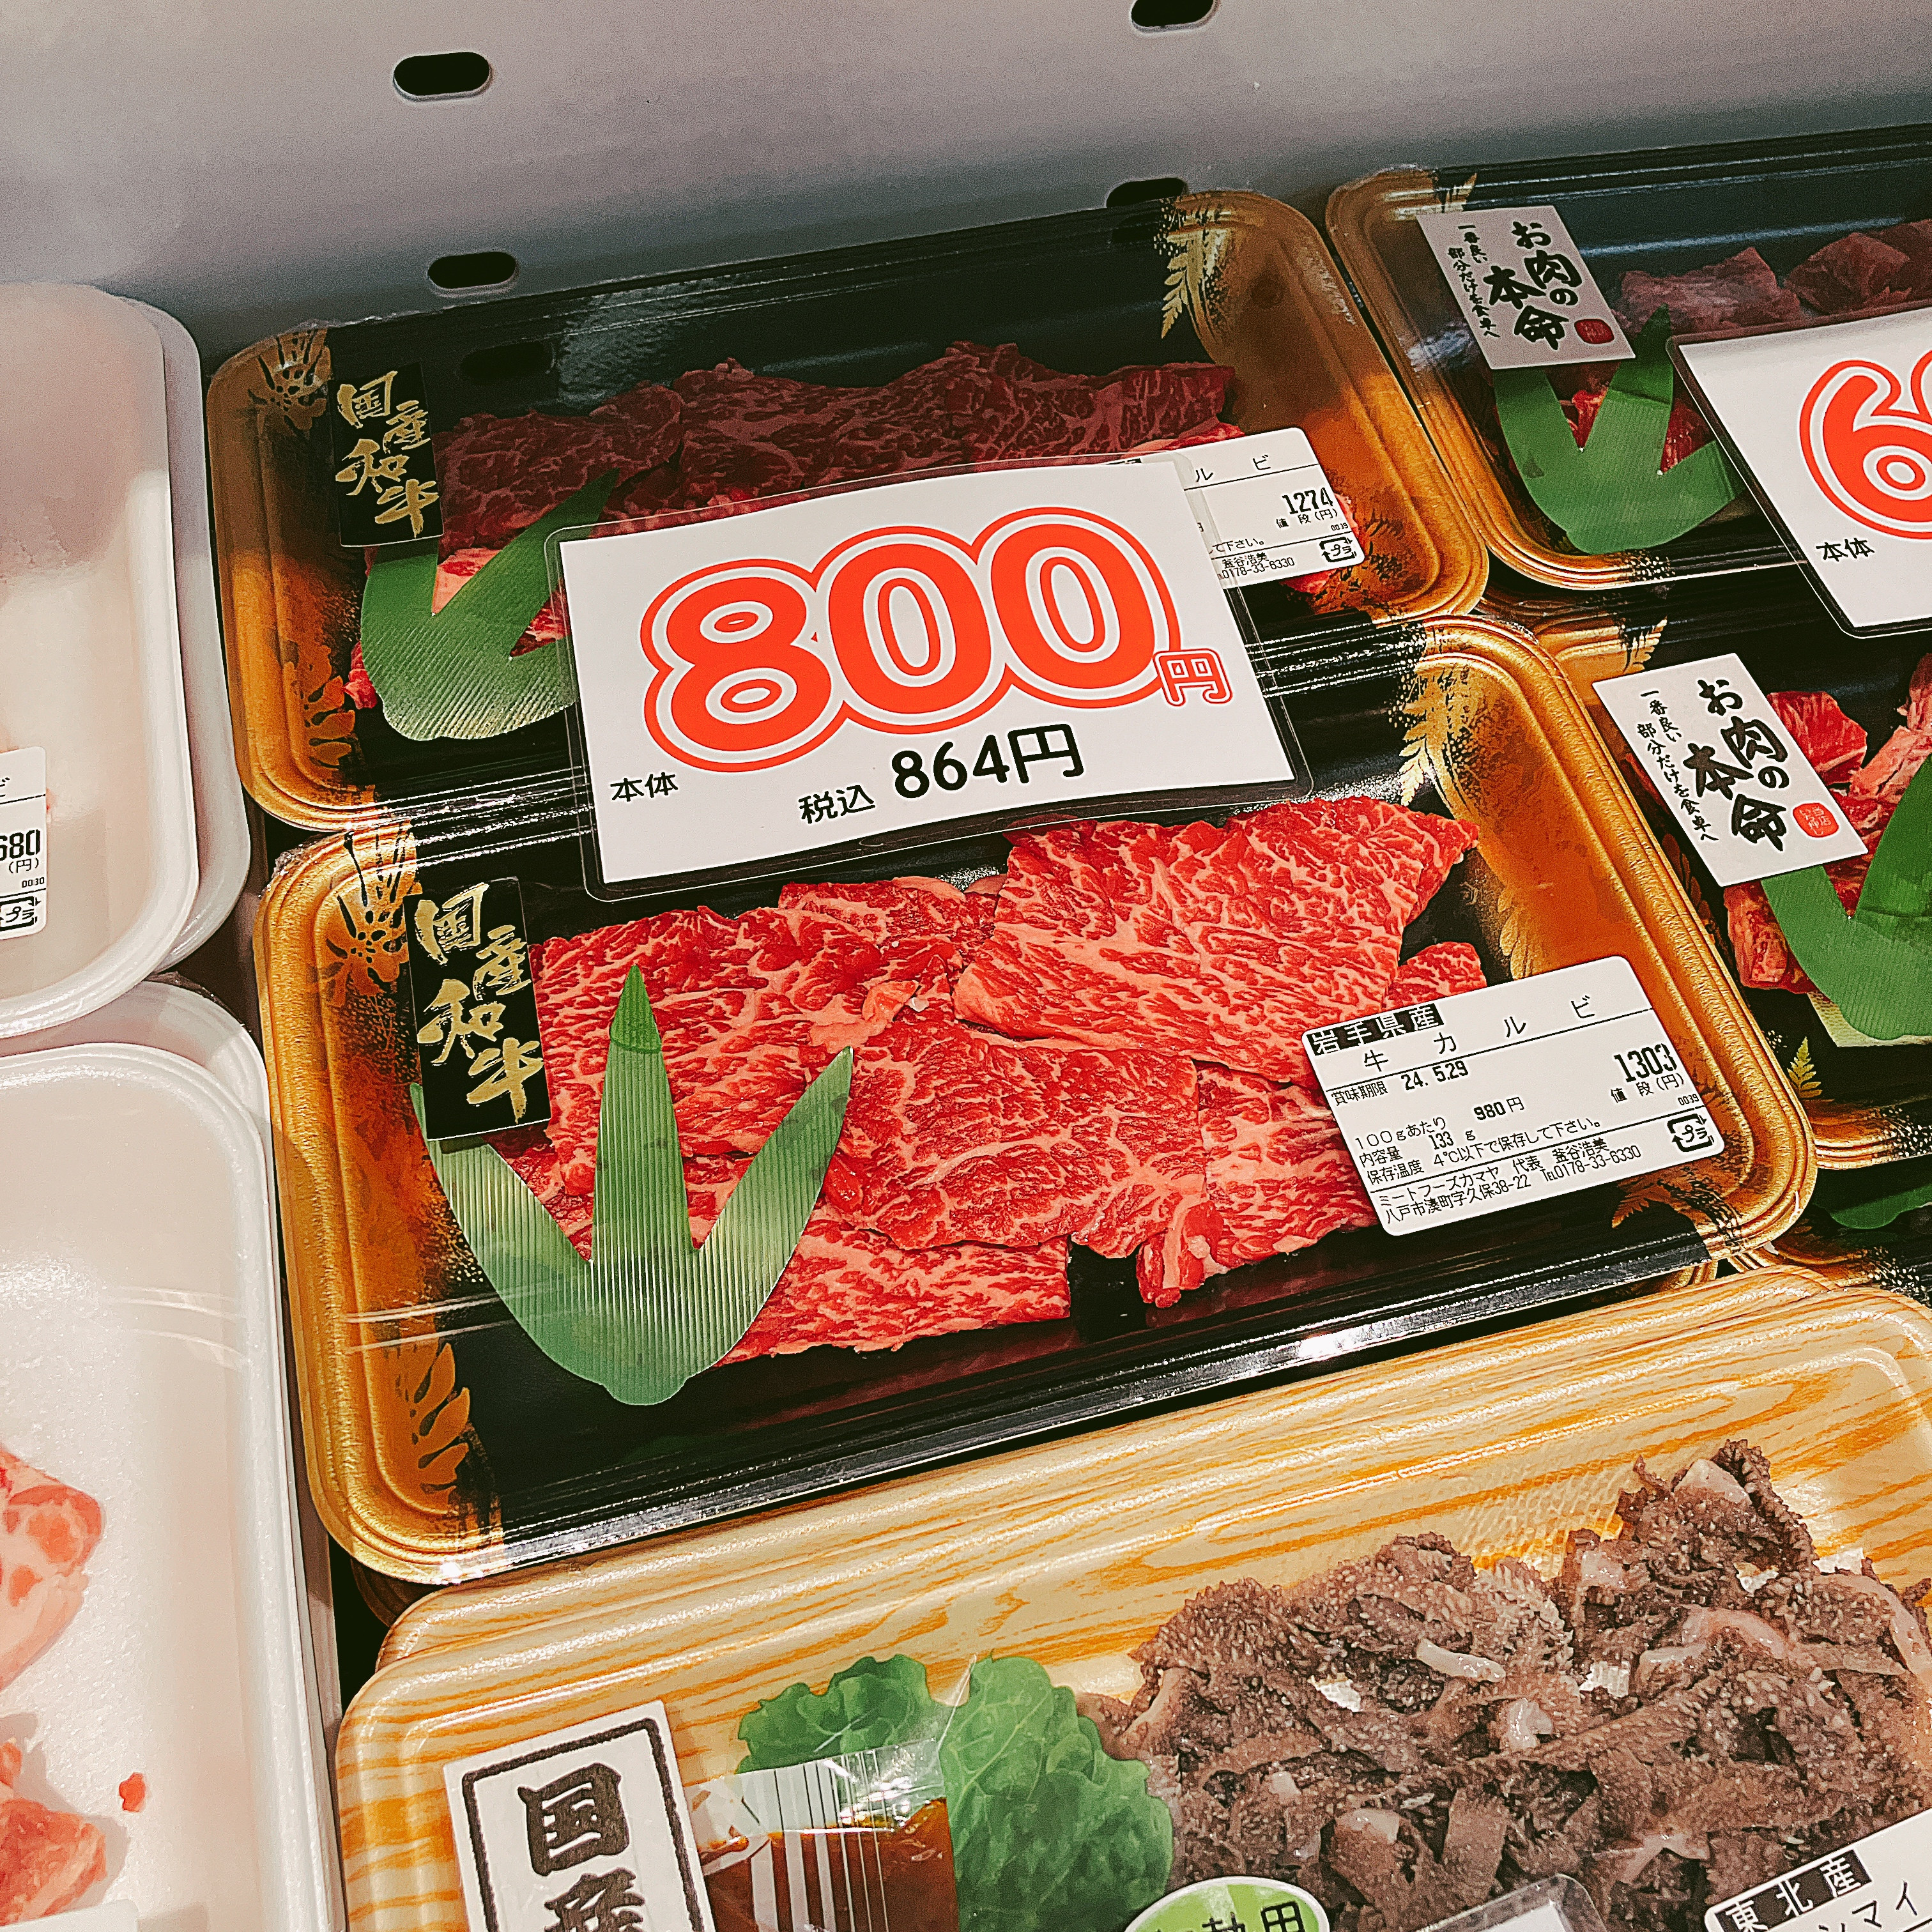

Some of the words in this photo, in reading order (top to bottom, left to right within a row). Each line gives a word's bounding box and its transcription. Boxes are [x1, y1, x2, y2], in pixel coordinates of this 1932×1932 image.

[1799, 349, 1932, 539] 6
[1282, 487, 1333, 514] 1274
[1816, 537, 1875, 562] 本体
[1640, 690, 1682, 742] 一番良い
[610, 771, 679, 802] 本体
[799, 785, 876, 824] 税込
[894, 723, 1085, 799] 864円
[1312, 1005, 1439, 1054] 岩手県産
[1364, 995, 1595, 1072] 牛カルビ
[1613, 1043, 1677, 1082] 1303
[1331, 1081, 1388, 1106] 賞味期限
[1678, 1093, 1699, 1106] 0039
[1359, 1146, 1404, 1168] 内容量
[1428, 1131, 1454, 1150] 133
[1379, 1167, 1499, 1206] ミートフーズカマヤ
[1513, 1155, 1543, 1174] 代表
[1552, 1137, 1610, 1163] 釜谷浩美
[1367, 1159, 1425, 1185] 保存温度
[1384, 1174, 1531, 1223] 八戸市湊町字久保38-22
[1725, 1856, 1862, 1932] 東北産
